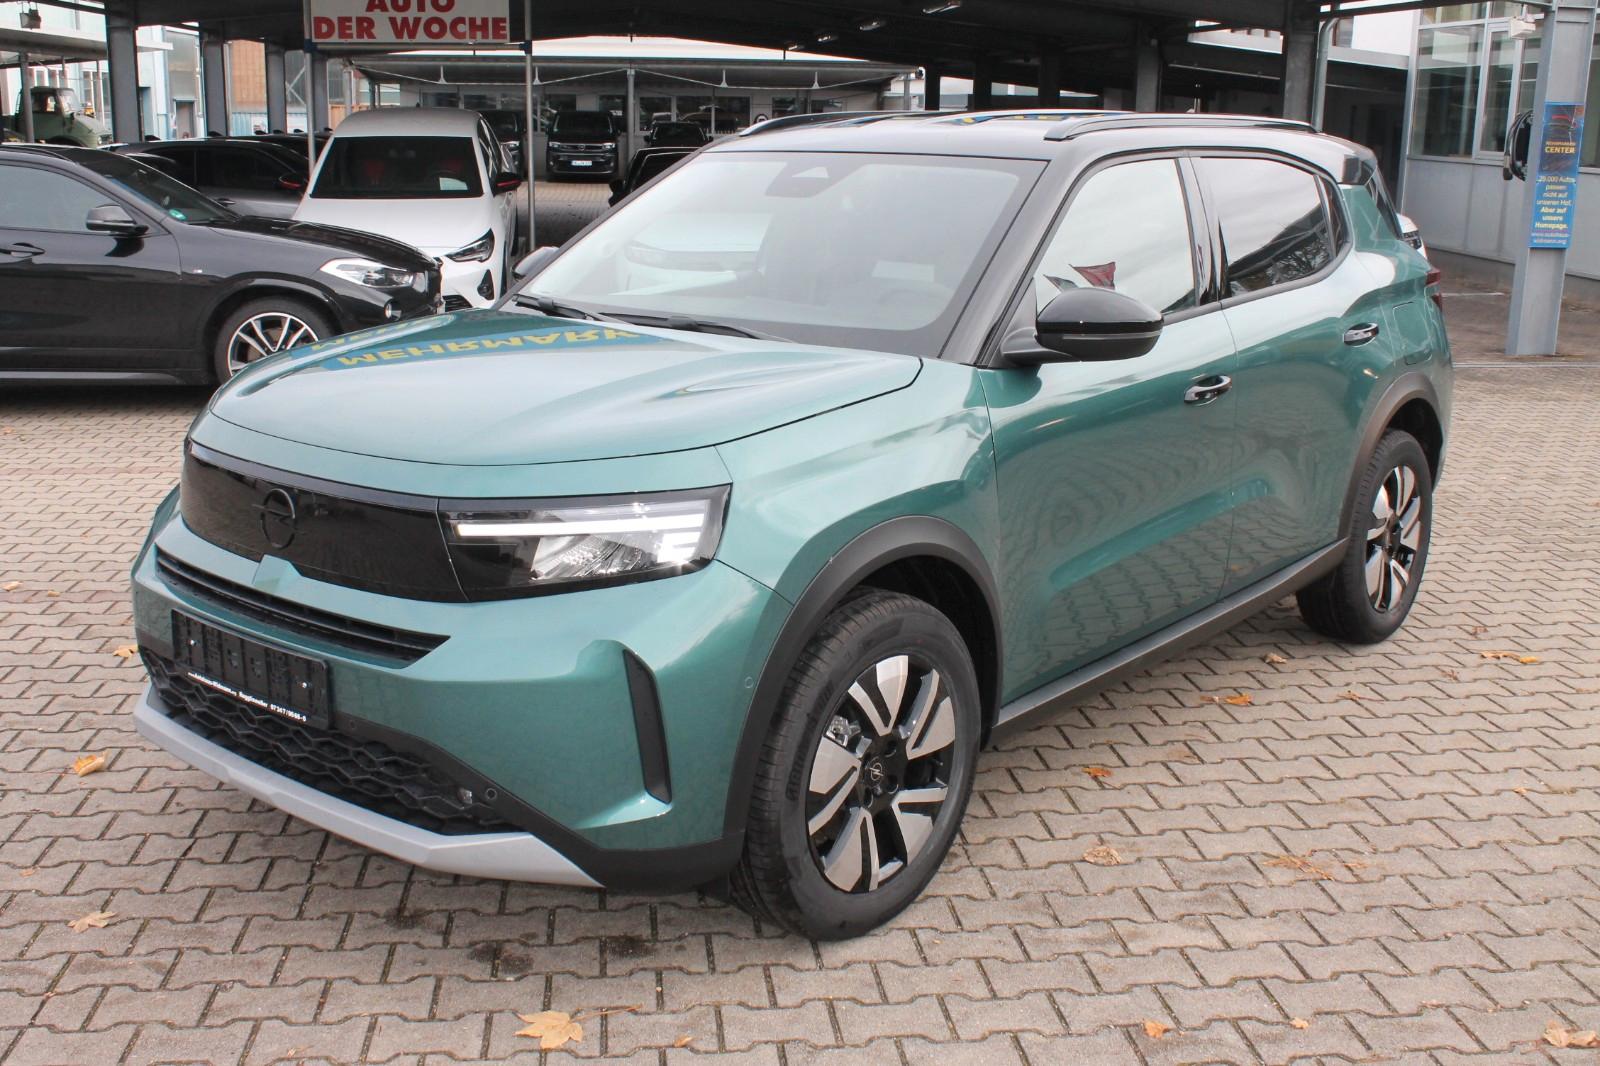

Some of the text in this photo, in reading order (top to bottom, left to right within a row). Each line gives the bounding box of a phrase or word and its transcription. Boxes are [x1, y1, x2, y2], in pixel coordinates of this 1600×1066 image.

[313, 16, 508, 40] DER WOCHE
[1544, 146, 1576, 154] CENTER
